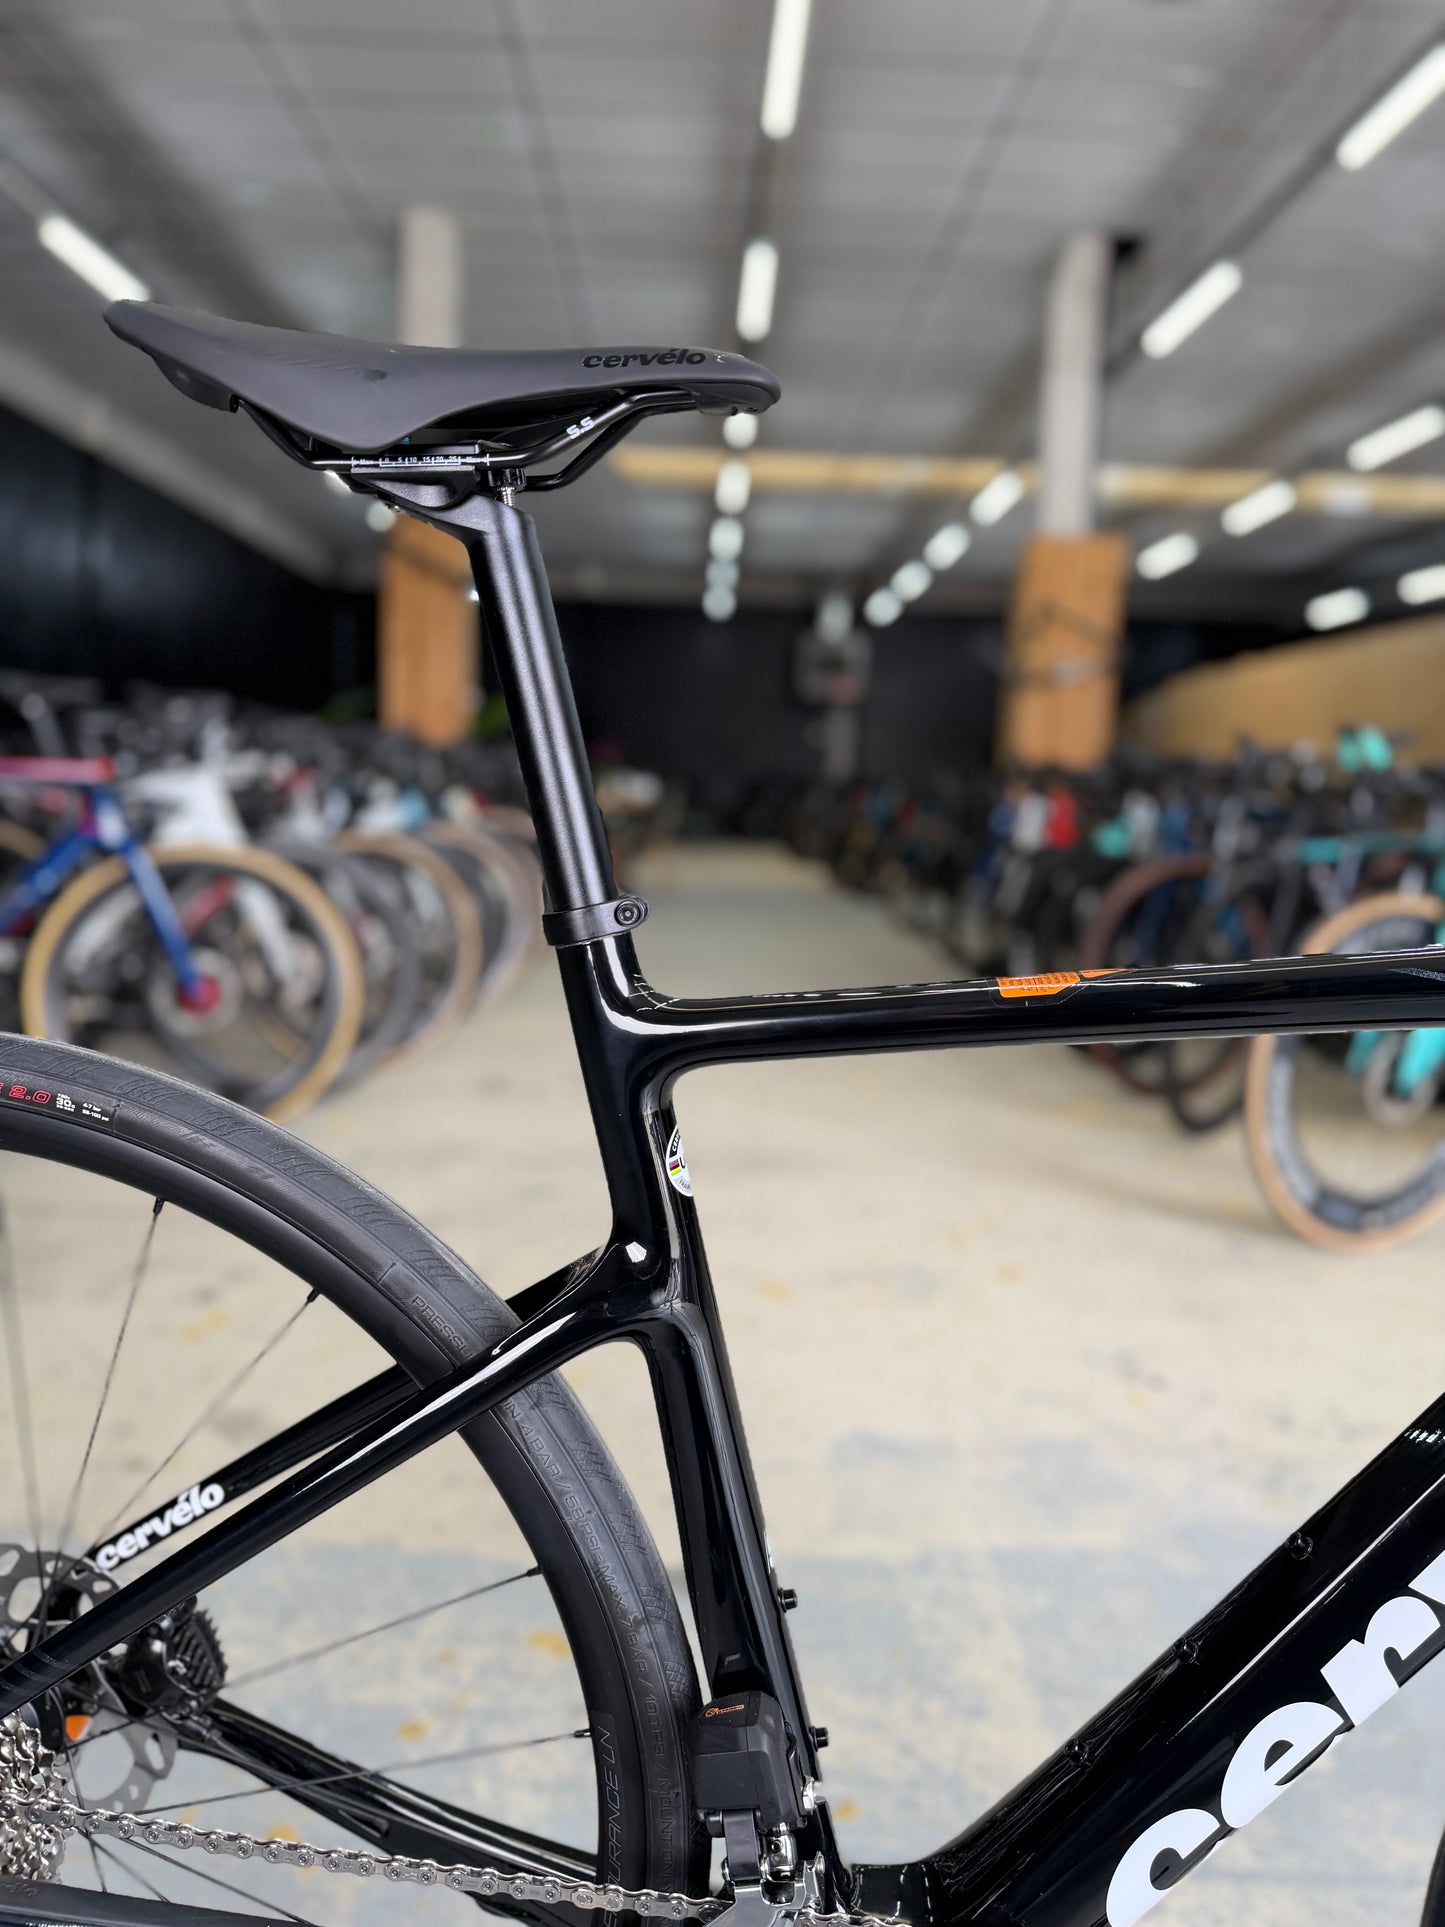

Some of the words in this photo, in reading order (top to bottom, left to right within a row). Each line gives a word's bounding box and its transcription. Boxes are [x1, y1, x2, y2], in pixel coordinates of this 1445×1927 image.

[582, 348, 707, 369] cervélo
[8, 1085, 52, 1105] 2.0
[411, 1295, 477, 1360] PRESSU
[96, 1483, 225, 1570] cervélo
[530, 1438, 563, 1478] BAR
[580, 1522, 602, 1553] PSI
[625, 1632, 648, 1673] BAR
